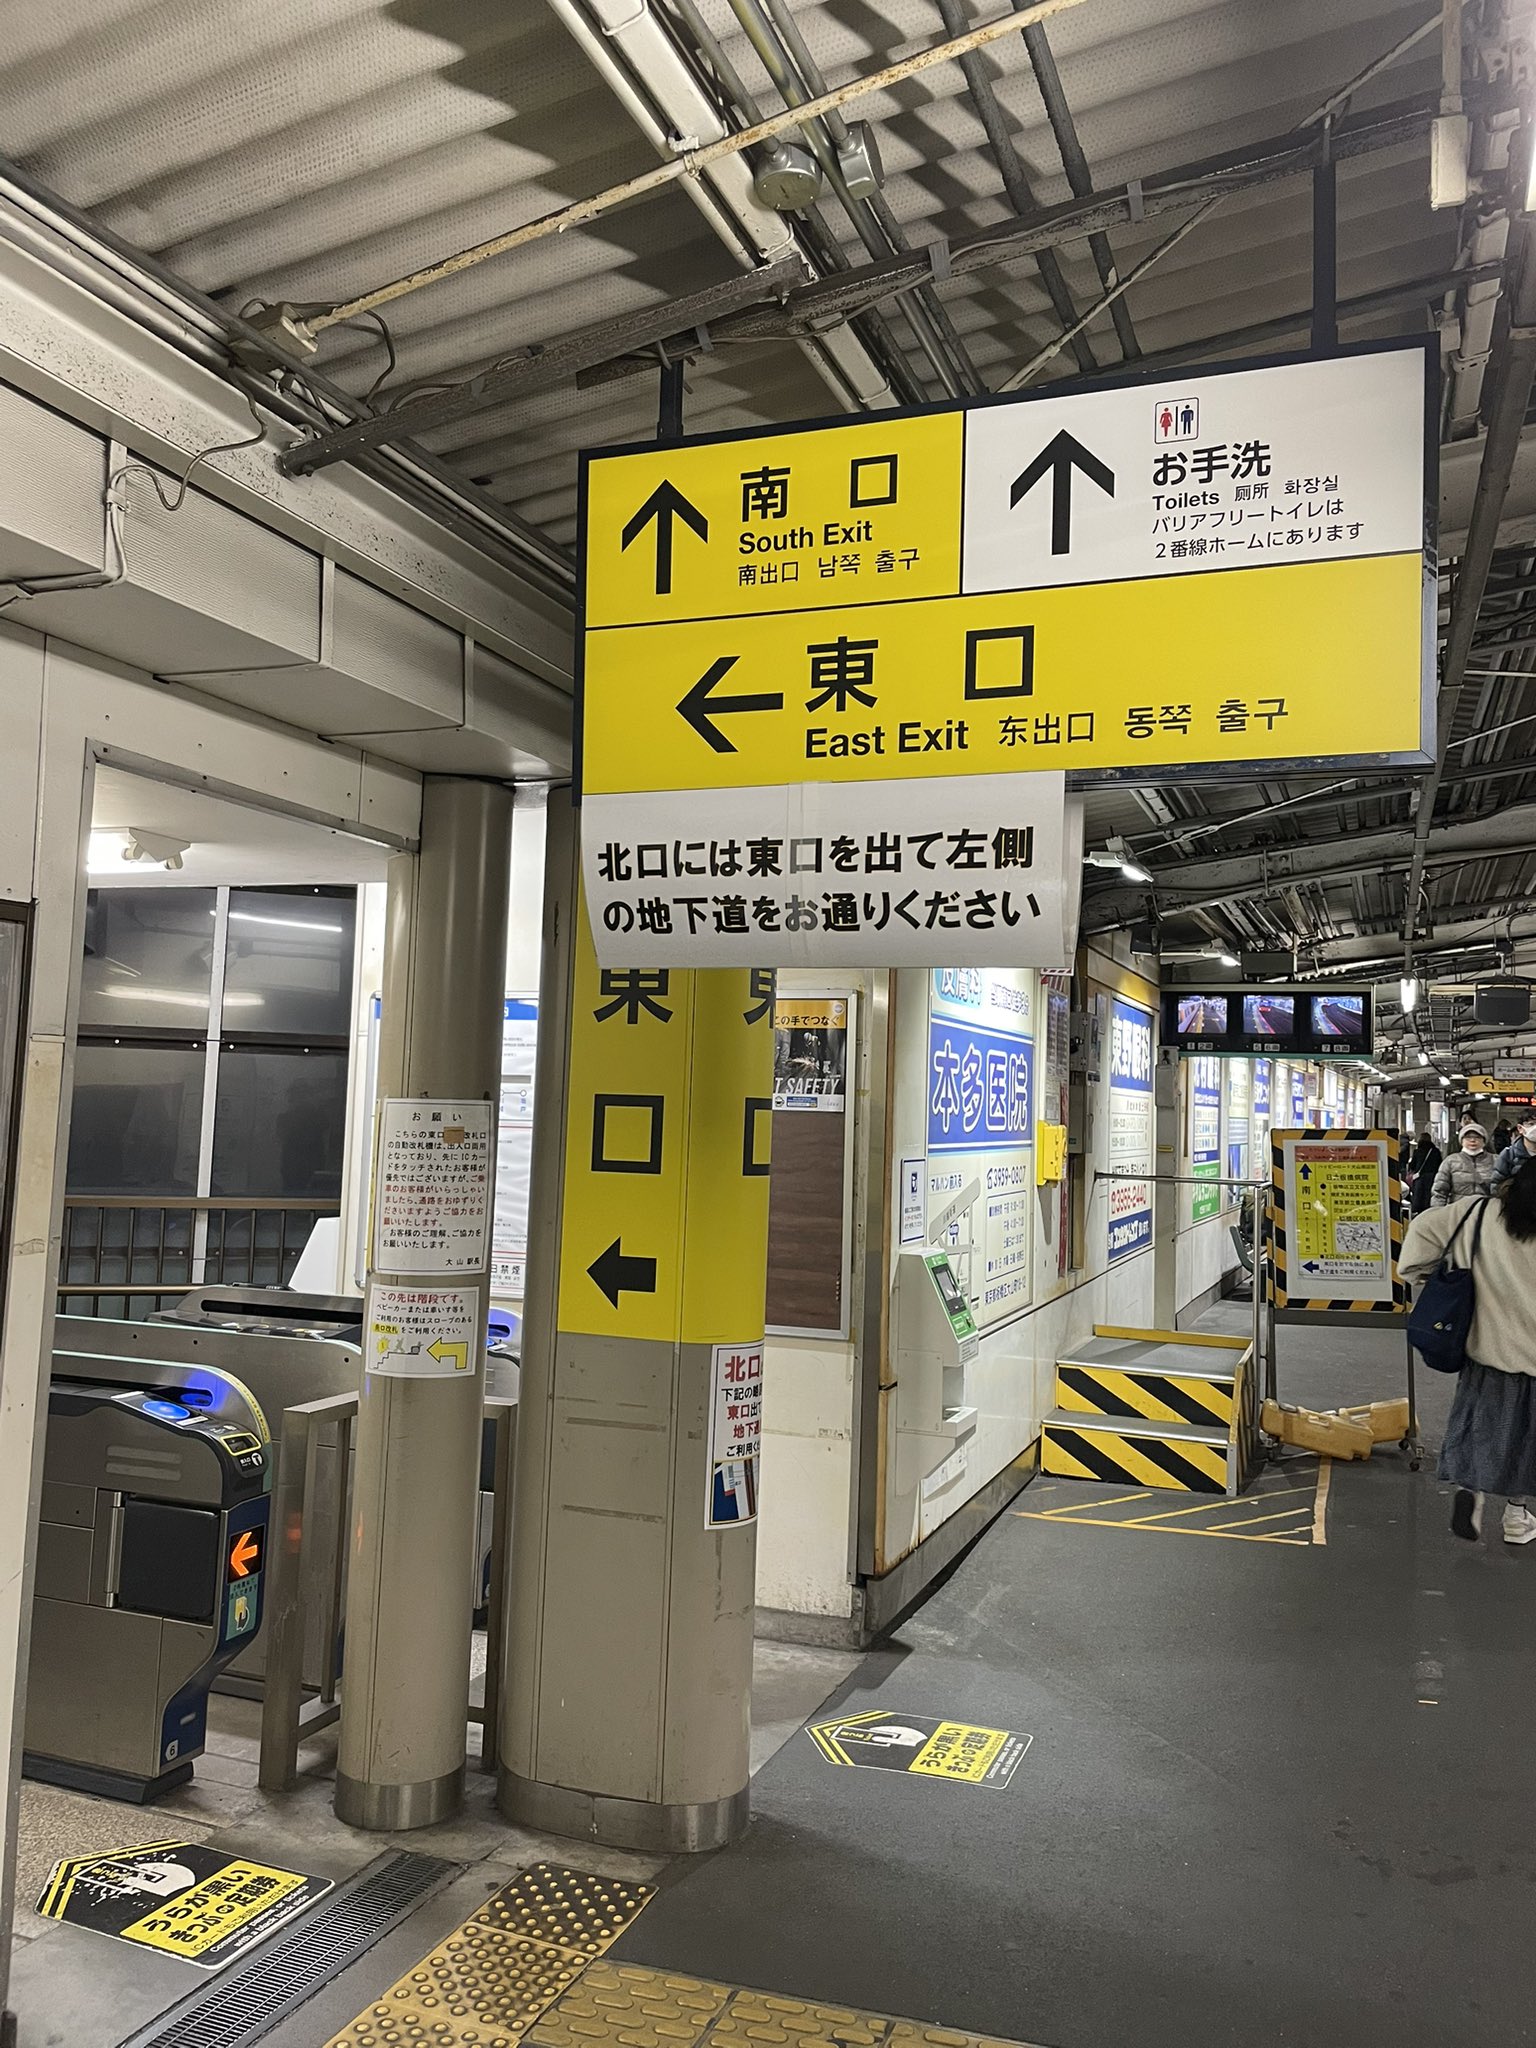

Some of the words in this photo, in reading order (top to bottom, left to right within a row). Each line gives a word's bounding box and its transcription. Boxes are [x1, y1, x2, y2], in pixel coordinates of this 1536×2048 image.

[1152, 440, 1271, 486] お手洗
[1152, 491, 1220, 511] Toilets
[1284, 475, 1339, 496] 화장실
[1152, 498, 1344, 534] バリアフリートイレは
[738, 527, 814, 555] South
[823, 520, 873, 546] Exit
[1155, 521, 1364, 559] 2番線ホームにあります
[738, 561, 799, 587] 南出口
[818, 553, 861, 578] 남쪽
[875, 548, 920, 574] 출구
[805, 725, 885, 759] East
[898, 718, 969, 754] Exit
[998, 712, 1095, 747] 东出口
[1124, 704, 1192, 739] 동쪽
[1215, 698, 1289, 734] 출구
[598, 826, 1034, 882] 北口には東口を出て左側
[603, 889, 1041, 935] の地下道をお通りください
[785, 1077, 840, 1095] SAFETY
[932, 1040, 1028, 1136] 本多医院
[412, 1112, 462, 1122] お願い
[381, 1291, 463, 1304] この先は階段です。
[725, 1354, 763, 1383] 北口
[170, 1745, 175, 1756] 6
[142, 1869, 252, 1933] うらが黒い
